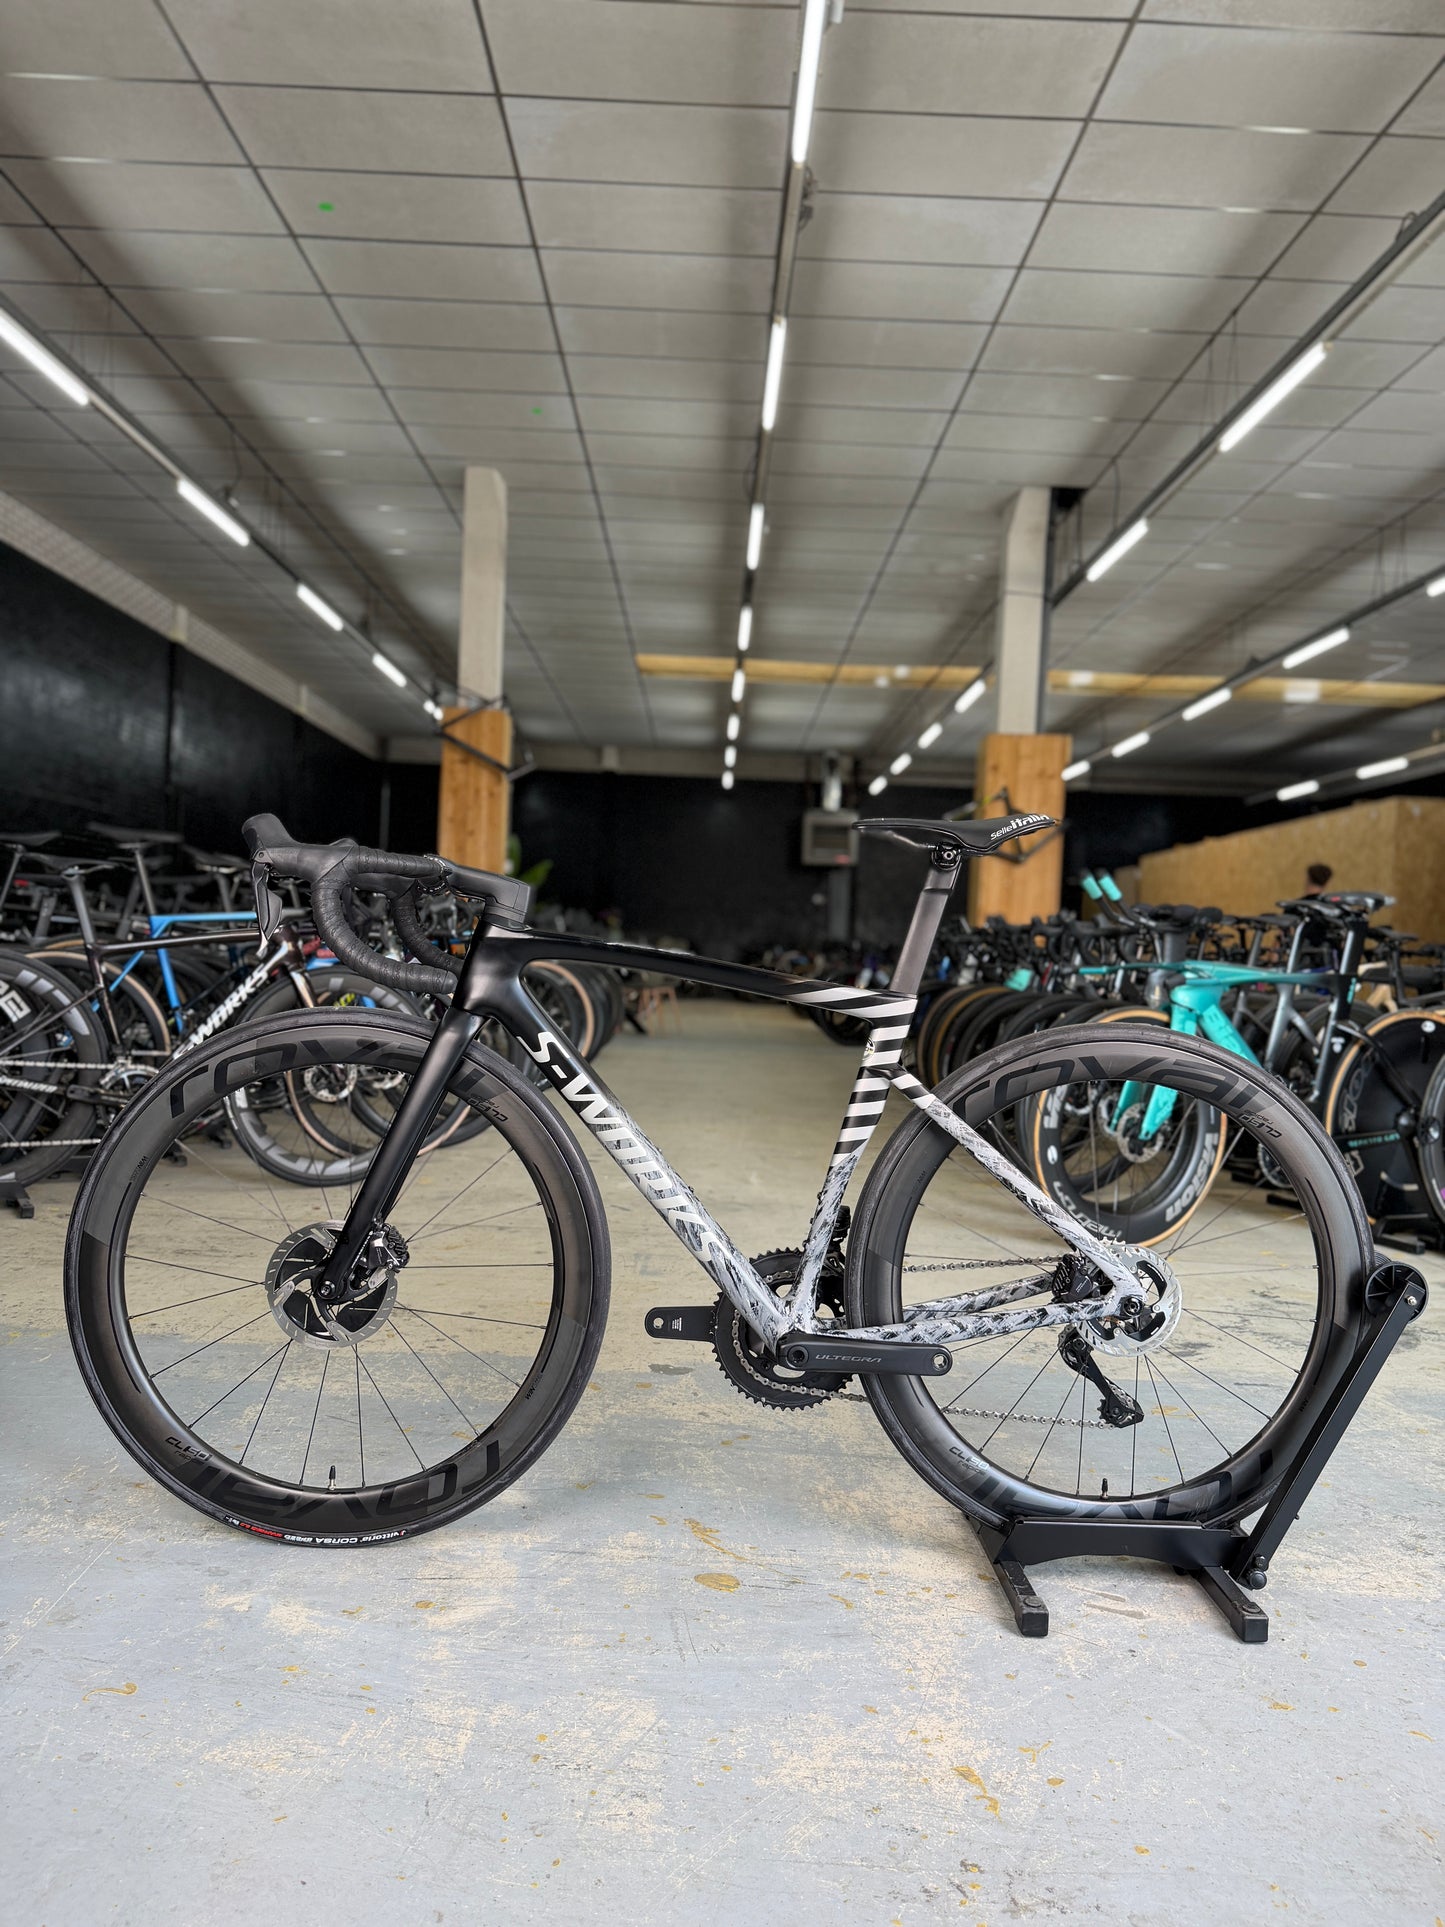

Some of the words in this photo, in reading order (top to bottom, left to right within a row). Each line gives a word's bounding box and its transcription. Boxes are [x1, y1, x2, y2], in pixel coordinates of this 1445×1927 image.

[516, 1031, 733, 1267] S-WORKS
[814, 1352, 883, 1364] ULTEGRA
[315, 1536, 358, 1544] CORSA
